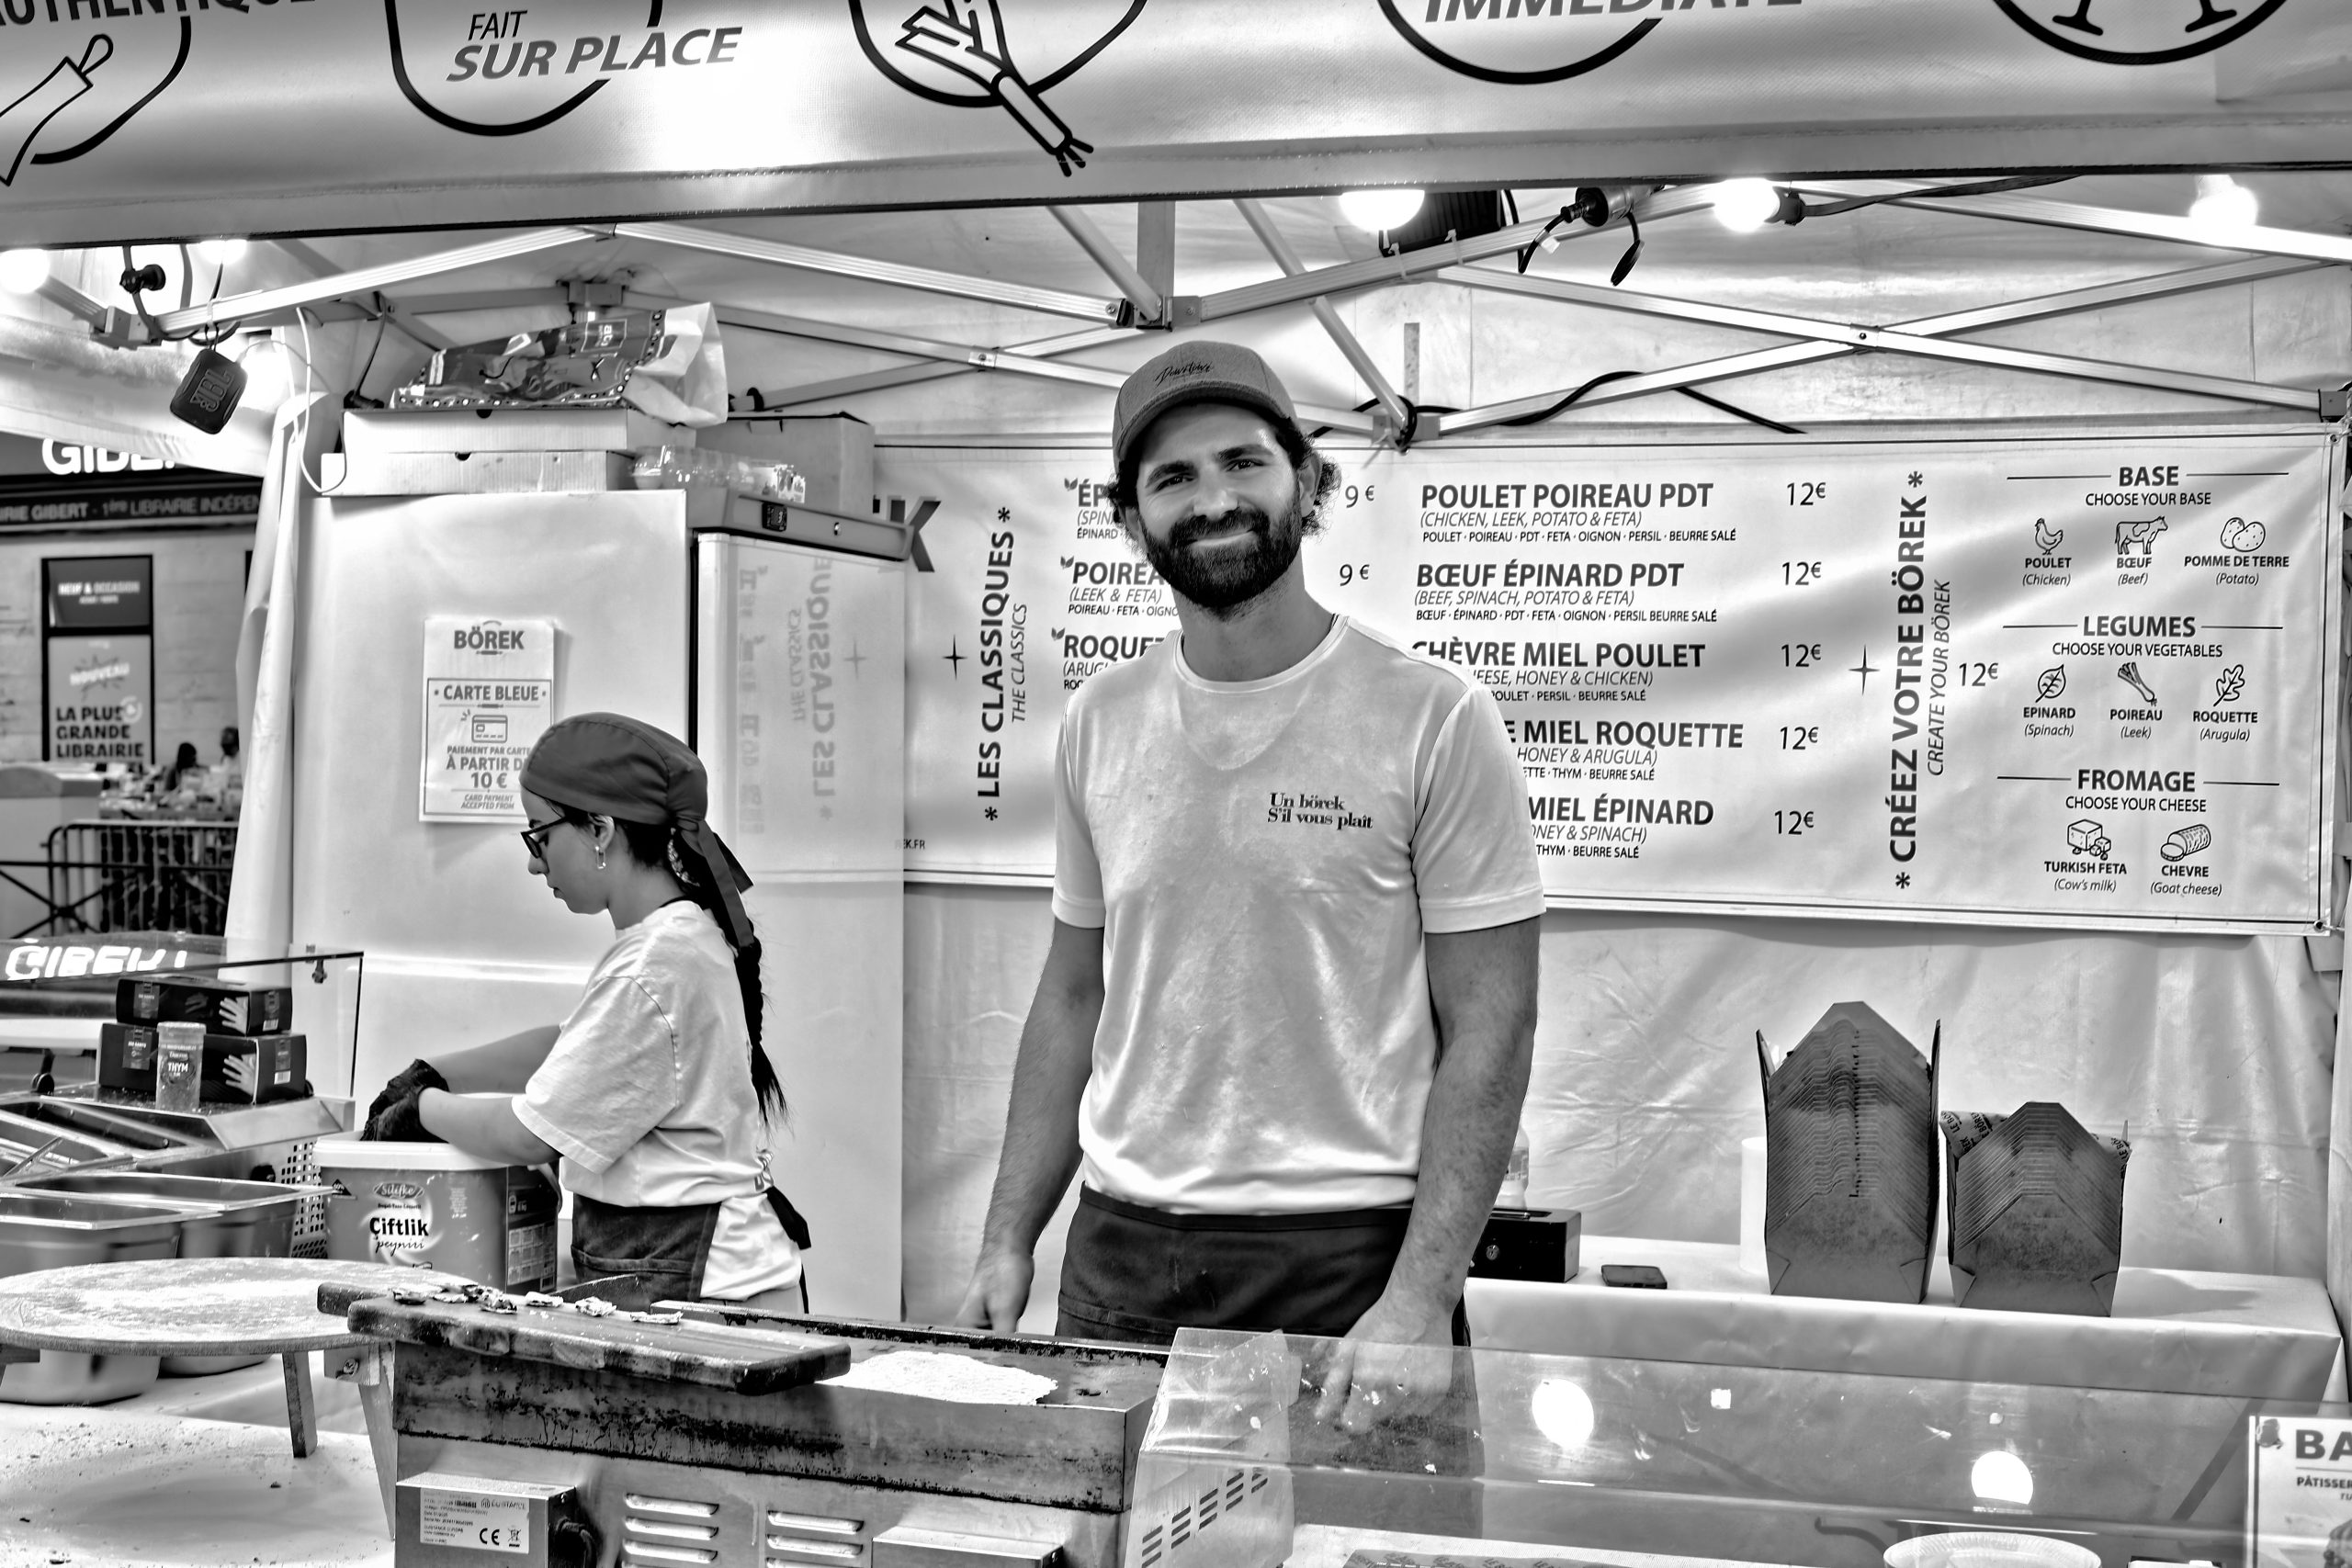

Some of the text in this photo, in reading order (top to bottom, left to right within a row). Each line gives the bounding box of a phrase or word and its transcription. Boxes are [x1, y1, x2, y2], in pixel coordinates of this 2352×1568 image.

[468, 10, 527, 40] FAIT
[446, 27, 743, 82] SUR PLACE
[2119, 466, 2179, 487] BASE
[1421, 482, 1714, 508] POULET POIREAU PDT
[1786, 482, 1826, 505] 12€
[2086, 492, 2211, 506] CHOOSE YOUR BASE
[1420, 512, 1642, 528] (CHICKEN, LEEK, POTATO & FETA)
[1077, 526, 1118, 539] ÉPINARD
[1423, 528, 1736, 542] POULET POIREAU PDT FETA OIGNON PERSIL BEURRE SALÉ
[2025, 558, 2072, 569] POULET
[2116, 557, 2152, 569] BŒUF
[2184, 556, 2290, 568] POMME DE TERRE
[1417, 558, 1685, 587] BŒUF ÉPINARD PDT
[1781, 561, 1822, 585] 12€
[2022, 574, 2071, 586] (Chicken)
[2118, 574, 2148, 586] (Beef)
[2215, 572, 2259, 586] (Potato)
[1069, 587, 1162, 604] (LEEK & FETA)
[1415, 590, 1634, 607] (BEEF, SPINACH, POTATO & FETA)
[1069, 604, 1139, 616] POIREAU FETA
[1416, 608, 1717, 622] BŒUF ÉPINARD PDT FETA OIGNON PERSIL BEURRE SALÉ
[2083, 615, 2196, 637] LEGUMES
[454, 626, 525, 649] BÖREK
[1522, 642, 1706, 668] MIEL POULET
[1781, 644, 1821, 667] 12€
[2052, 643, 2222, 658] CHOOSE YOUR VEGETABLES
[978, 531, 1014, 797] LES CLASSIQUES
[1011, 603, 1027, 722] THE CLASSICS
[1516, 670, 1653, 687] HONEY & CHICKEN)
[1885, 495, 1928, 862] CRÉEZ VOTRE BÖREK
[1928, 580, 1951, 775] CREATE YOUR BÖREK
[1958, 662, 1999, 687] 12€
[444, 685, 539, 702] CARTE BLEUE
[1537, 689, 1646, 702] PERSIL BEURRE SALÉ
[57, 707, 75, 721] LA
[2023, 707, 2076, 719] EPINARD
[2109, 709, 2163, 721] POIREAU
[2193, 711, 2258, 724] ROQUETTE
[57, 725, 130, 739] GRANDE
[1523, 720, 1589, 744] MIEL
[1596, 720, 1744, 750] ROQUETTE
[1780, 727, 1818, 750] 12€
[2024, 724, 2074, 738] (Spinach)
[2120, 726, 2152, 739] (Leek)
[2199, 728, 2250, 742] (Arugula)
[57, 743, 143, 758] LIBRAIRIE
[447, 745, 489, 754] PAIEMENT
[446, 754, 509, 771] À PARTIR
[1570, 748, 1580, 763] &
[1583, 749, 1658, 768] ARUGULA)
[471, 772, 492, 788] 10
[1554, 768, 1655, 781] THYM BEURRE SALÉ
[2077, 769, 2196, 793] FROMAGE
[1270, 793, 1345, 810] Un börek
[1529, 793, 1714, 826] MIEL ÉPINARD
[2065, 796, 2207, 812] CHOOSE YOUR CHEESE
[1296, 814, 1332, 825] vous
[1337, 812, 1373, 830] plaît
[1774, 810, 1814, 835] 12€
[1566, 826, 1647, 844] & SPINACH)
[1536, 844, 1639, 858] THYM BEURRE SALÉ
[2044, 861, 2127, 874] TURKISH FETA
[2161, 864, 2210, 877] CHEVRE
[2054, 879, 2117, 893] (Cow's milk)
[2150, 882, 2222, 897] (Goat cheese)
[168, 1062, 189, 1073] THYM
[369, 1217, 429, 1239] Çiftlik
